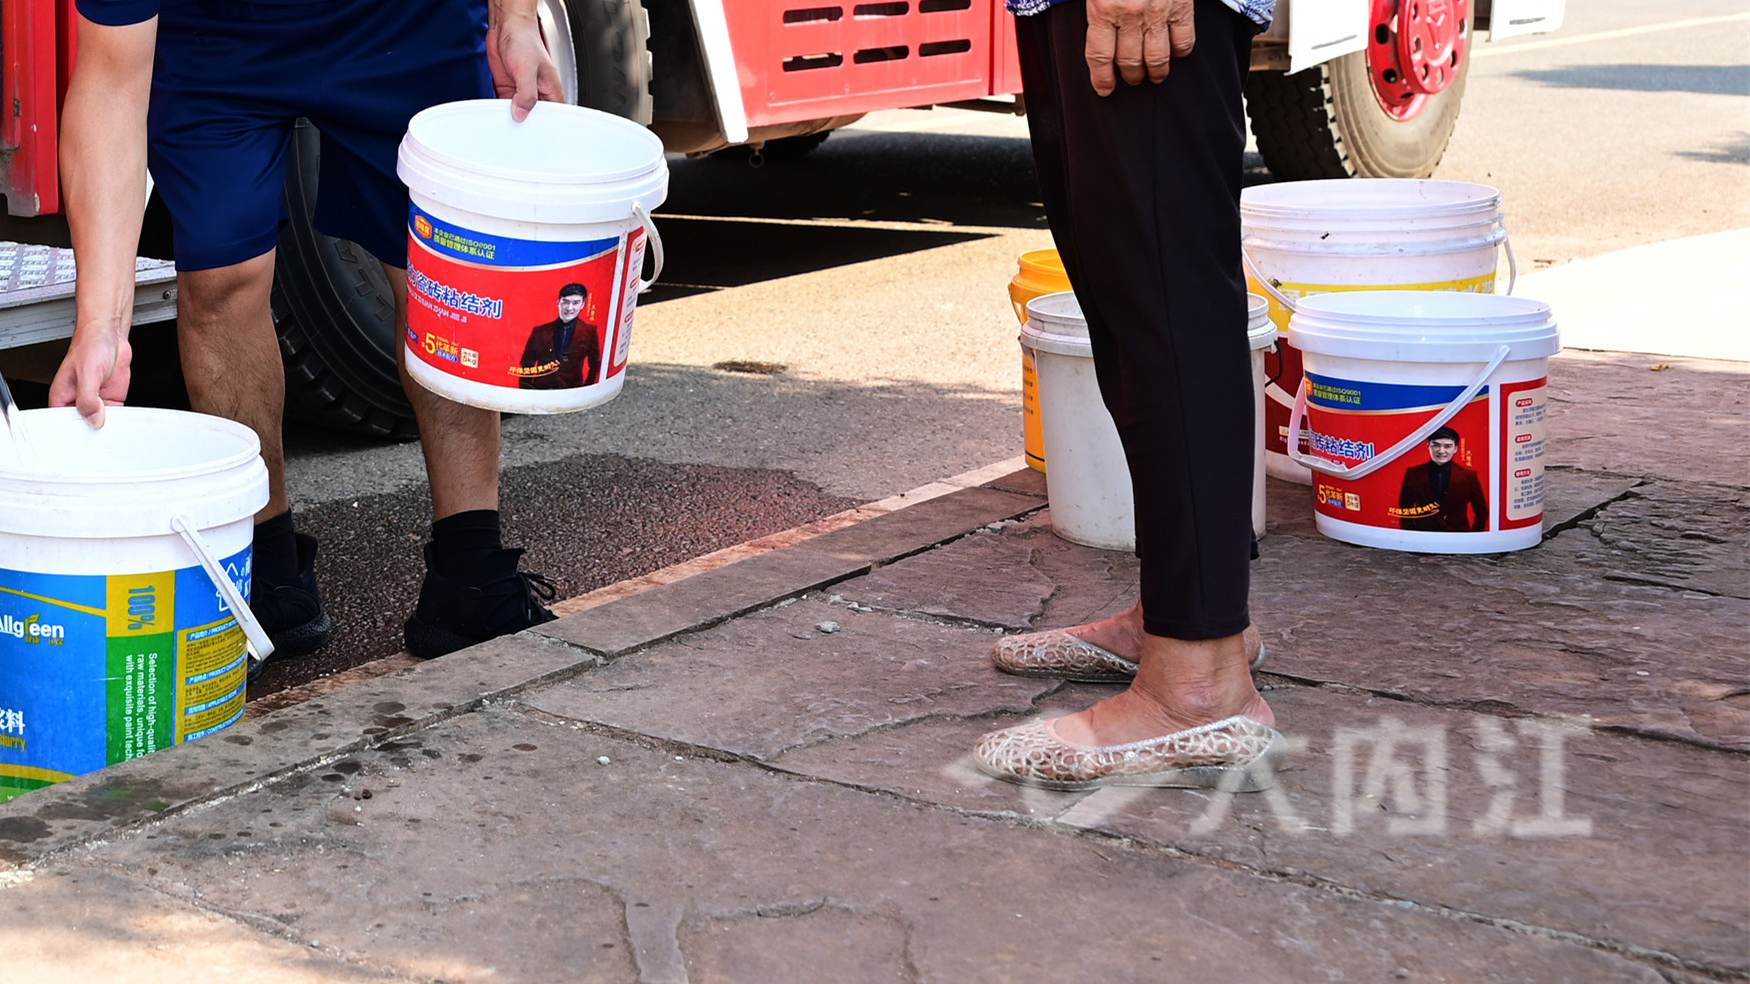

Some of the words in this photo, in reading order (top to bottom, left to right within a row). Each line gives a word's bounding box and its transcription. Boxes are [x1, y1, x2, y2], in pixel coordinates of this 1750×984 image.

[1310, 429, 1375, 460] 砖粘结剂
[128, 586, 155, 630] 100%
[125, 654, 134, 673] with
[137, 654, 145, 671] raw
[148, 653, 158, 694] Selection
[123, 675, 134, 715] exquisite
[136, 672, 146, 716] materials,
[148, 696, 157, 705] of
[124, 716, 134, 739] paint
[135, 717, 145, 748] unique
[145, 706, 157, 755] high-qualit
[125, 740, 134, 761] tech
